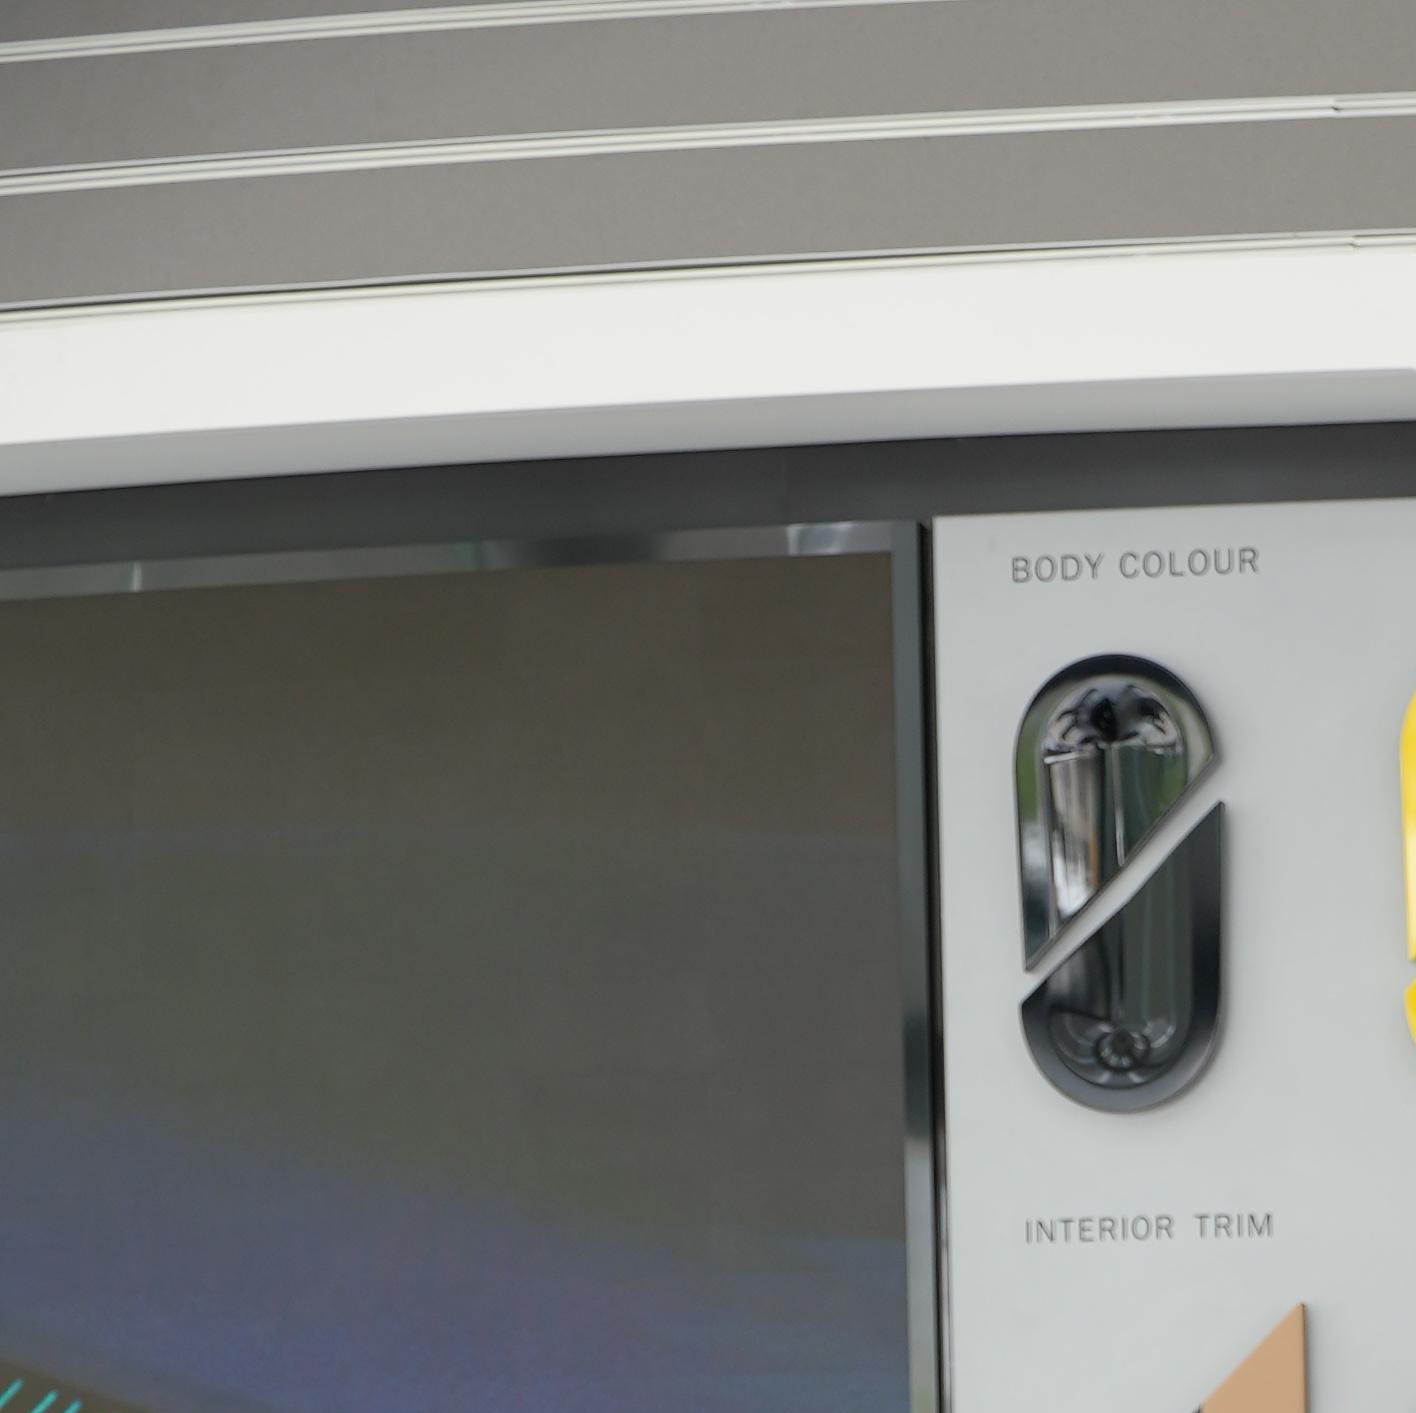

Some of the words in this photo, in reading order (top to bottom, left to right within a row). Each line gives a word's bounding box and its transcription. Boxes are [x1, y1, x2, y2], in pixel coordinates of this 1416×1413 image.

[1010, 552, 1105, 583] BODY
[1118, 546, 1260, 579] COLOUR
[1024, 1214, 1176, 1244] INTERIOR
[1194, 1212, 1274, 1239] TRIM
